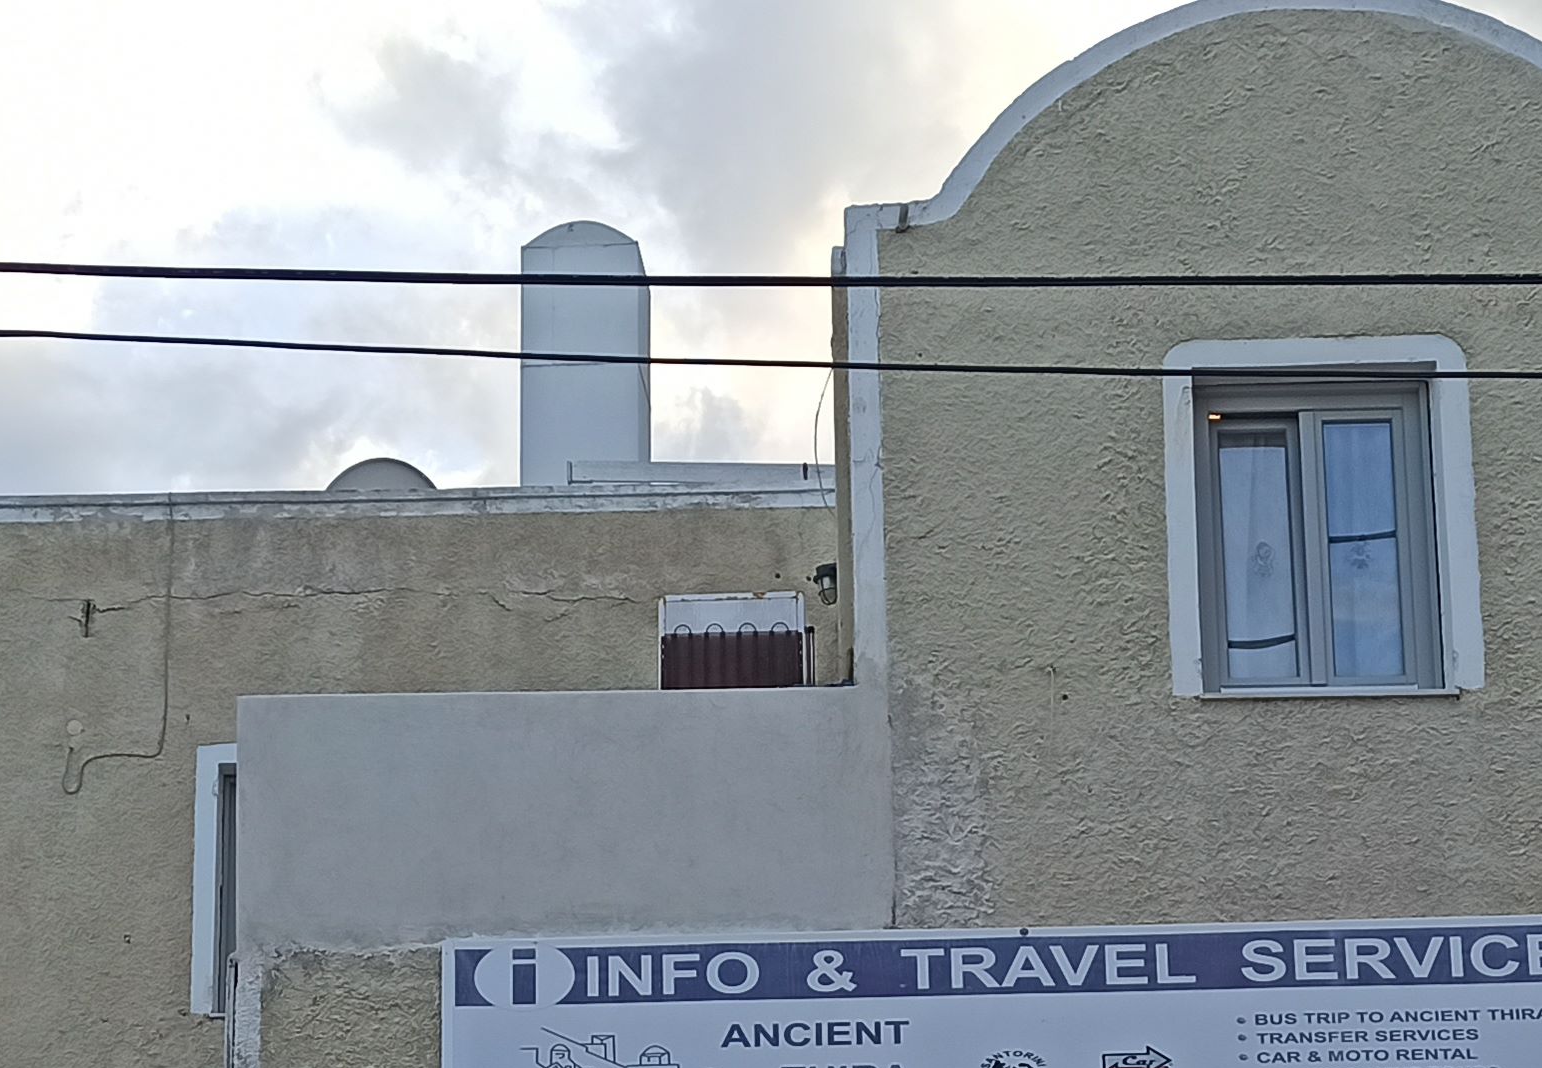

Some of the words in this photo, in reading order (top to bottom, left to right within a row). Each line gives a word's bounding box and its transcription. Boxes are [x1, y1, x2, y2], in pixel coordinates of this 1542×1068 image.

[586, 951, 760, 997] INFO
[806, 949, 858, 992] &
[900, 943, 1197, 991] TRAVEL
[1255, 1013, 1297, 1026] BUS
[1304, 1012, 1350, 1025] TRIP
[1356, 1011, 1384, 1024] TO
[1390, 1009, 1480, 1023] ANCIENT
[720, 1021, 910, 1049] ANCIENT
[1257, 1031, 1368, 1045] TRANSFER
[1375, 1028, 1479, 1042] SERVICES
[1122, 1055, 1157, 1068] Car
[1257, 1051, 1300, 1064] CAR
[1308, 1050, 1322, 1062] &
[1328, 1049, 1389, 1062] MOTO
[1396, 1048, 1478, 1061] RENTAL
